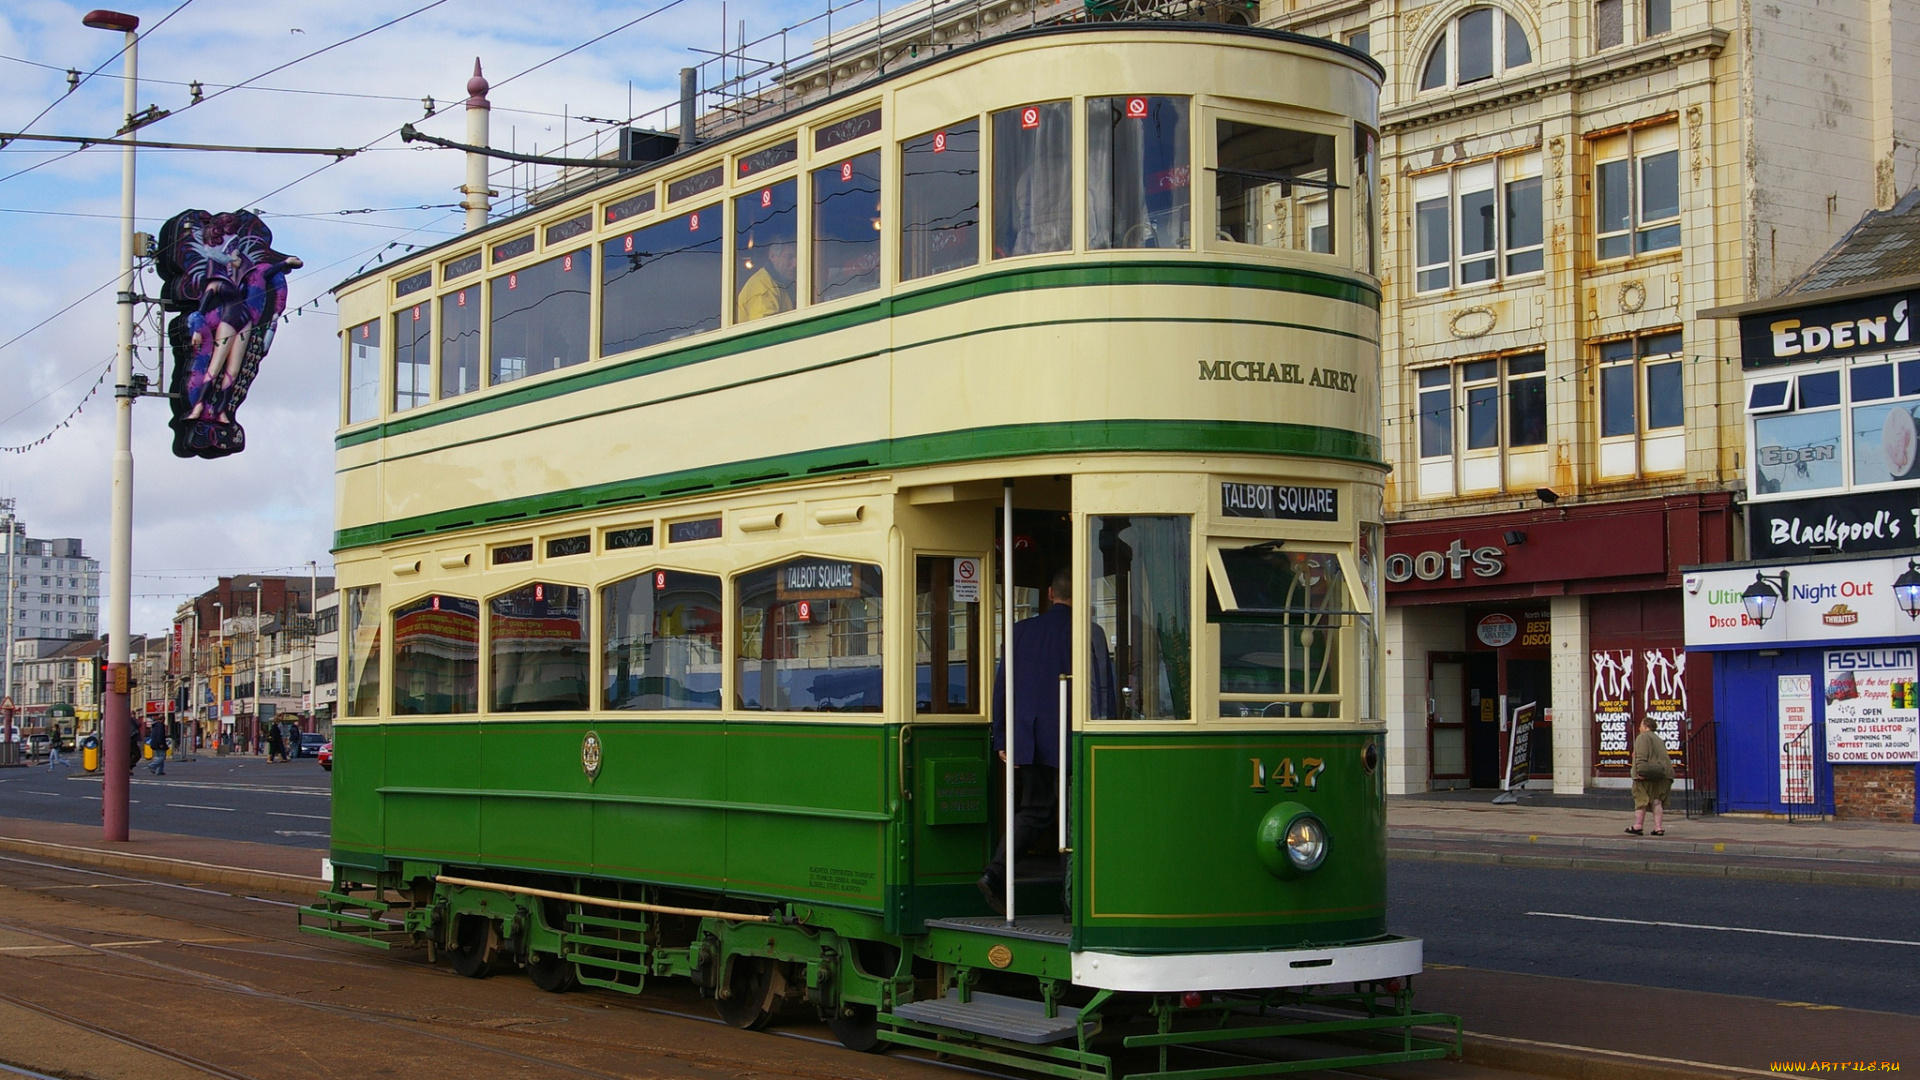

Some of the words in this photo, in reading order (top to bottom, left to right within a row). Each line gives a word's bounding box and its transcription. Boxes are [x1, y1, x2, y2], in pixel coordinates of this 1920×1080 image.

[1770, 316, 1887, 357] EDEN
[1198, 360, 1304, 384] MICHAEL
[1309, 367, 1358, 393] AIREY
[1760, 445, 1835, 466] EDEN
[1223, 483, 1274, 510] TALBOT
[1278, 487, 1333, 513] SQUARE
[1770, 510, 1900, 549] Blackpool's
[787, 566, 817, 588] TALBOT
[818, 565, 852, 589] SQUARE
[1793, 583, 1837, 604] Night
[1841, 581, 1873, 597] Out
[1526, 621, 1551, 633] BEST
[1828, 650, 1914, 669] ASYLUM
[1866, 676, 1876, 686] the
[1595, 712, 1630, 722] NAUGHTY
[1601, 722, 1626, 731] GLASS
[1656, 721, 1678, 731] LASS
[1600, 731, 1627, 741] DANCE
[1600, 741, 1628, 750] FLOOR!
[1828, 752, 1840, 760] SO
[1843, 752, 1868, 760] COME
[1871, 752, 1884, 760] ON
[1249, 757, 1326, 793] 147
